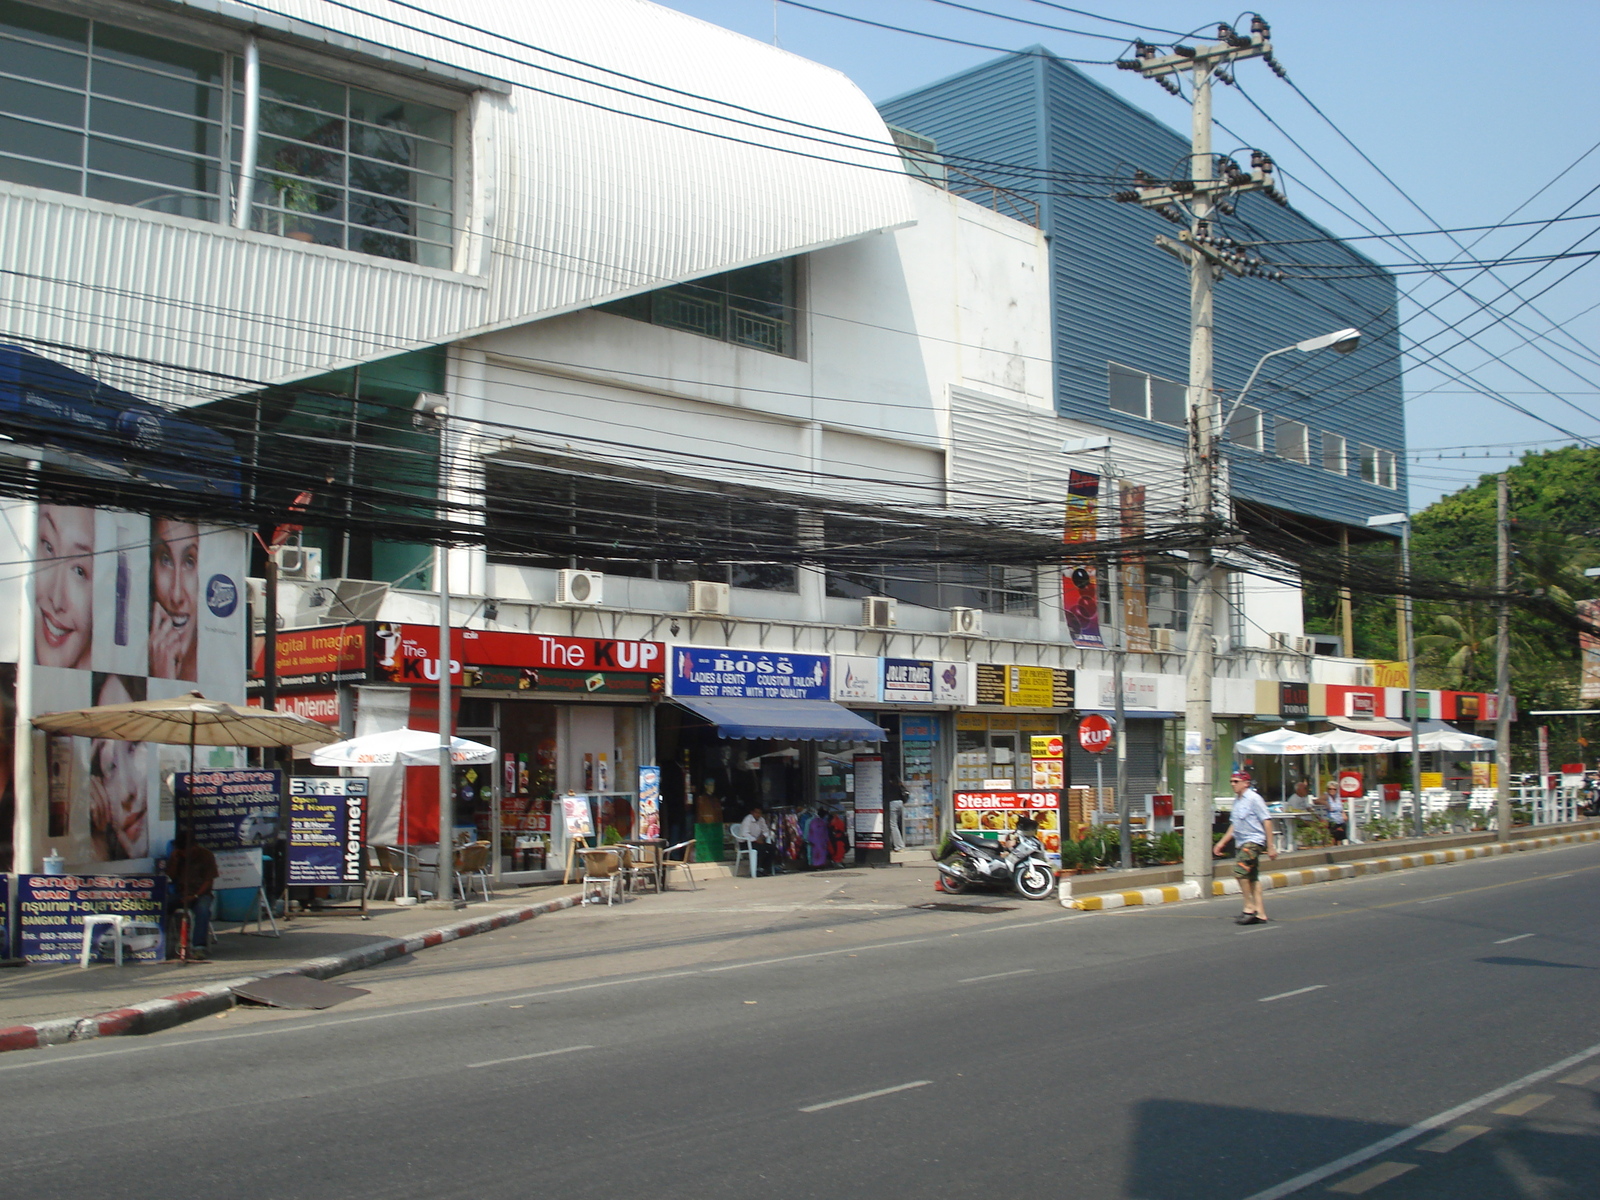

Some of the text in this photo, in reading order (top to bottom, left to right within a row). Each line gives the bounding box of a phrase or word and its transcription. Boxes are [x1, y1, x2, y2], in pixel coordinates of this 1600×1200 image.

[276, 634, 362, 656] igital Imaging
[402, 644, 427, 658] The
[538, 636, 659, 669] The KUP
[299, 655, 327, 665] Internet
[713, 658, 795, 675] BOSS
[403, 658, 460, 681] KUP
[1376, 664, 1409, 688] TOPS
[689, 671, 815, 688] LADIES & GENTS COUSTOM TAILOR
[700, 684, 808, 699] BEST PRICE WITH TOP QUALITY
[1283, 688, 1309, 704] HAIR
[294, 692, 340, 717] Internet
[1284, 705, 1309, 714] TODAY
[1080, 728, 1112, 745] KUP
[221, 783, 273, 794] SERVICE
[291, 796, 318, 805] Open
[307, 804, 337, 812] Hours
[957, 793, 1002, 808] Steak
[343, 797, 362, 880] internet
[31, 890, 152, 900] VAN SERVICE
[21, 915, 68, 926] BANGKOK
